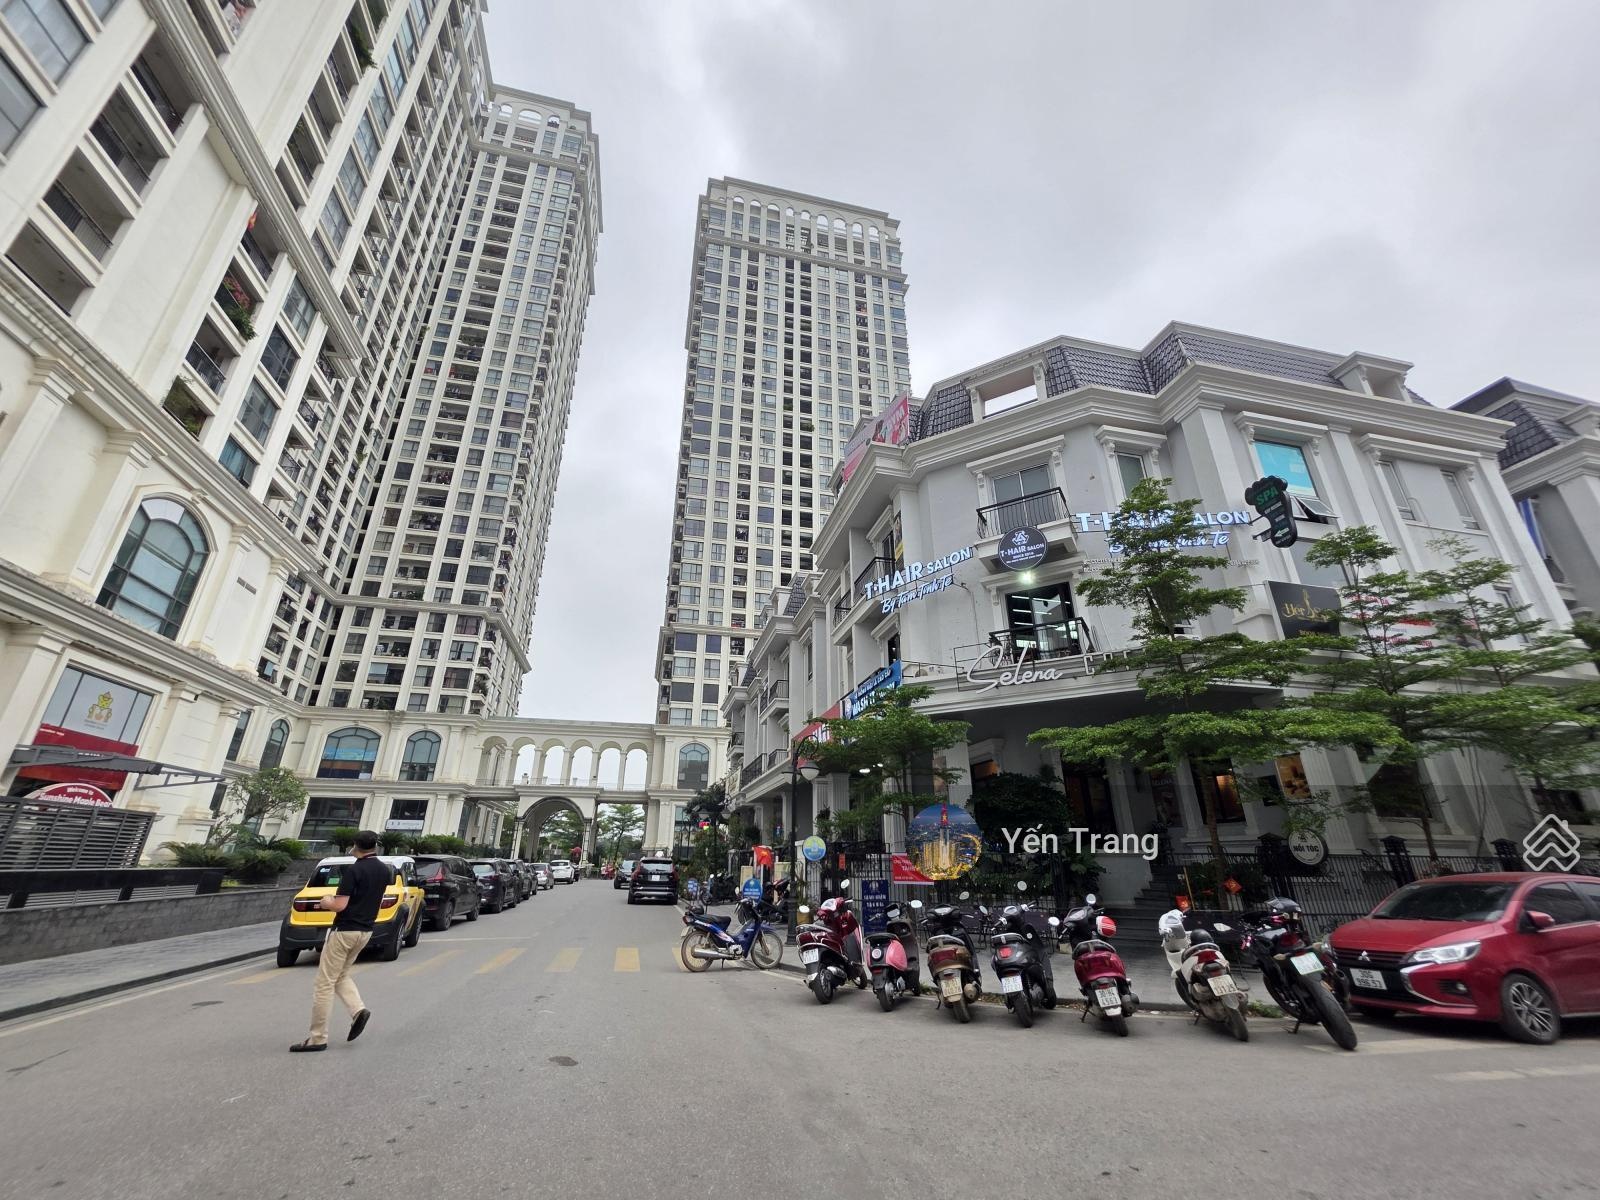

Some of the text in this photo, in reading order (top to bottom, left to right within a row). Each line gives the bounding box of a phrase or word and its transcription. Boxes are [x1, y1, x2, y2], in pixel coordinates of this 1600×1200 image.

[1257, 486, 1279, 505] SPA
[1193, 511, 1250, 525] ALON
[926, 546, 973, 574] SALON
[967, 643, 1063, 693] Selena
[39, 792, 73, 804] Sunshine
